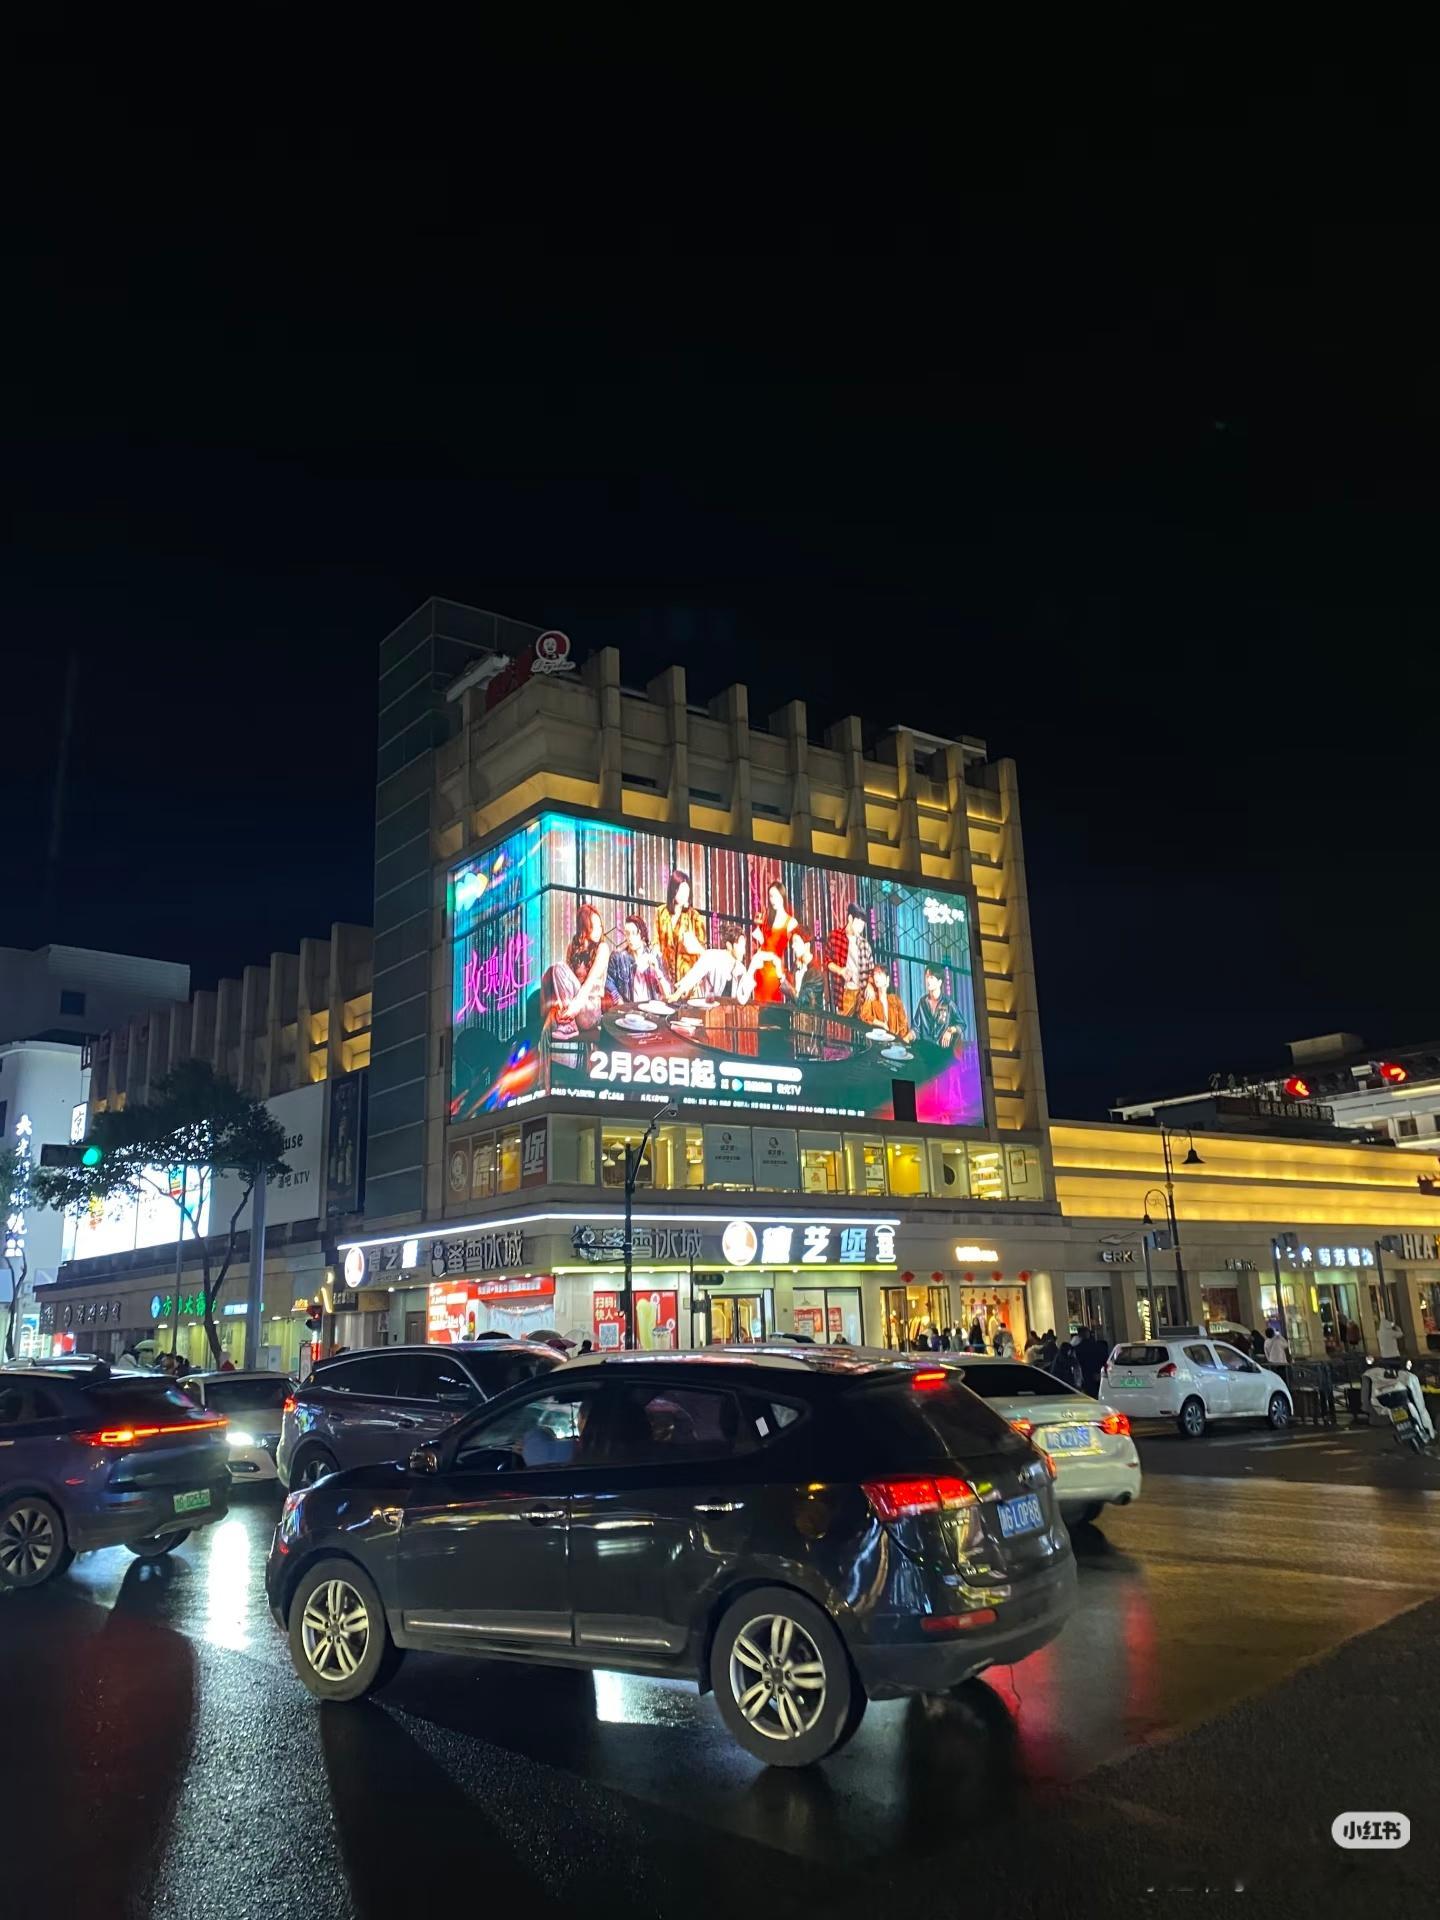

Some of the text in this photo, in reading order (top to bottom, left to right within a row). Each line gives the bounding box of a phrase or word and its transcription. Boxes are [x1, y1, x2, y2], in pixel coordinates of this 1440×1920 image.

[589, 1050, 716, 1089] 2月26日起
[294, 1170, 310, 1184] KTV
[446, 1229, 523, 1273] 蜜雪冰城
[1402, 1234, 1435, 1260] HLA
